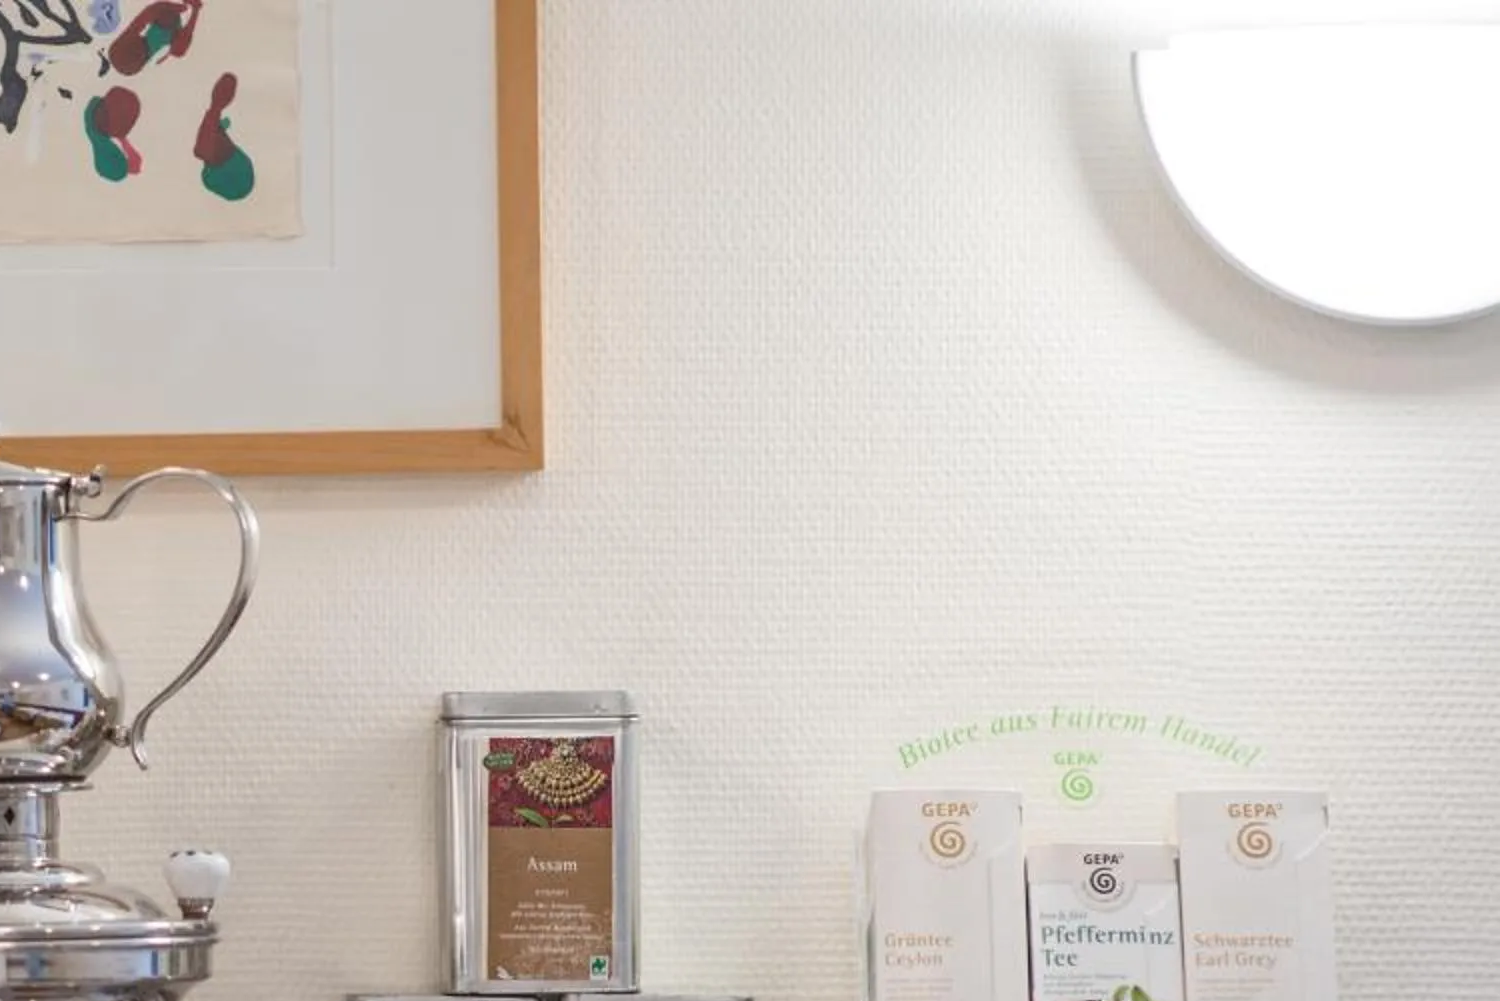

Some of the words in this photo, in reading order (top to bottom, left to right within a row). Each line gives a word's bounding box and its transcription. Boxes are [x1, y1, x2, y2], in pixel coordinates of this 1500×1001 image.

[899, 721, 980, 769] Biotee
[990, 711, 1039, 736] aus
[1049, 704, 1149, 734] Fairem
[1160, 714, 1266, 767] Handel
[527, 856, 578, 873] Assam
[884, 931, 954, 949] Grüntee
[1040, 925, 1175, 946] Pfefferminz
[1192, 932, 1294, 948] Schwarztee
[885, 951, 943, 969] Ceylon
[1042, 948, 1078, 968] Tee
[1195, 950, 1229, 967] Earl
[1235, 951, 1277, 970] Grey
